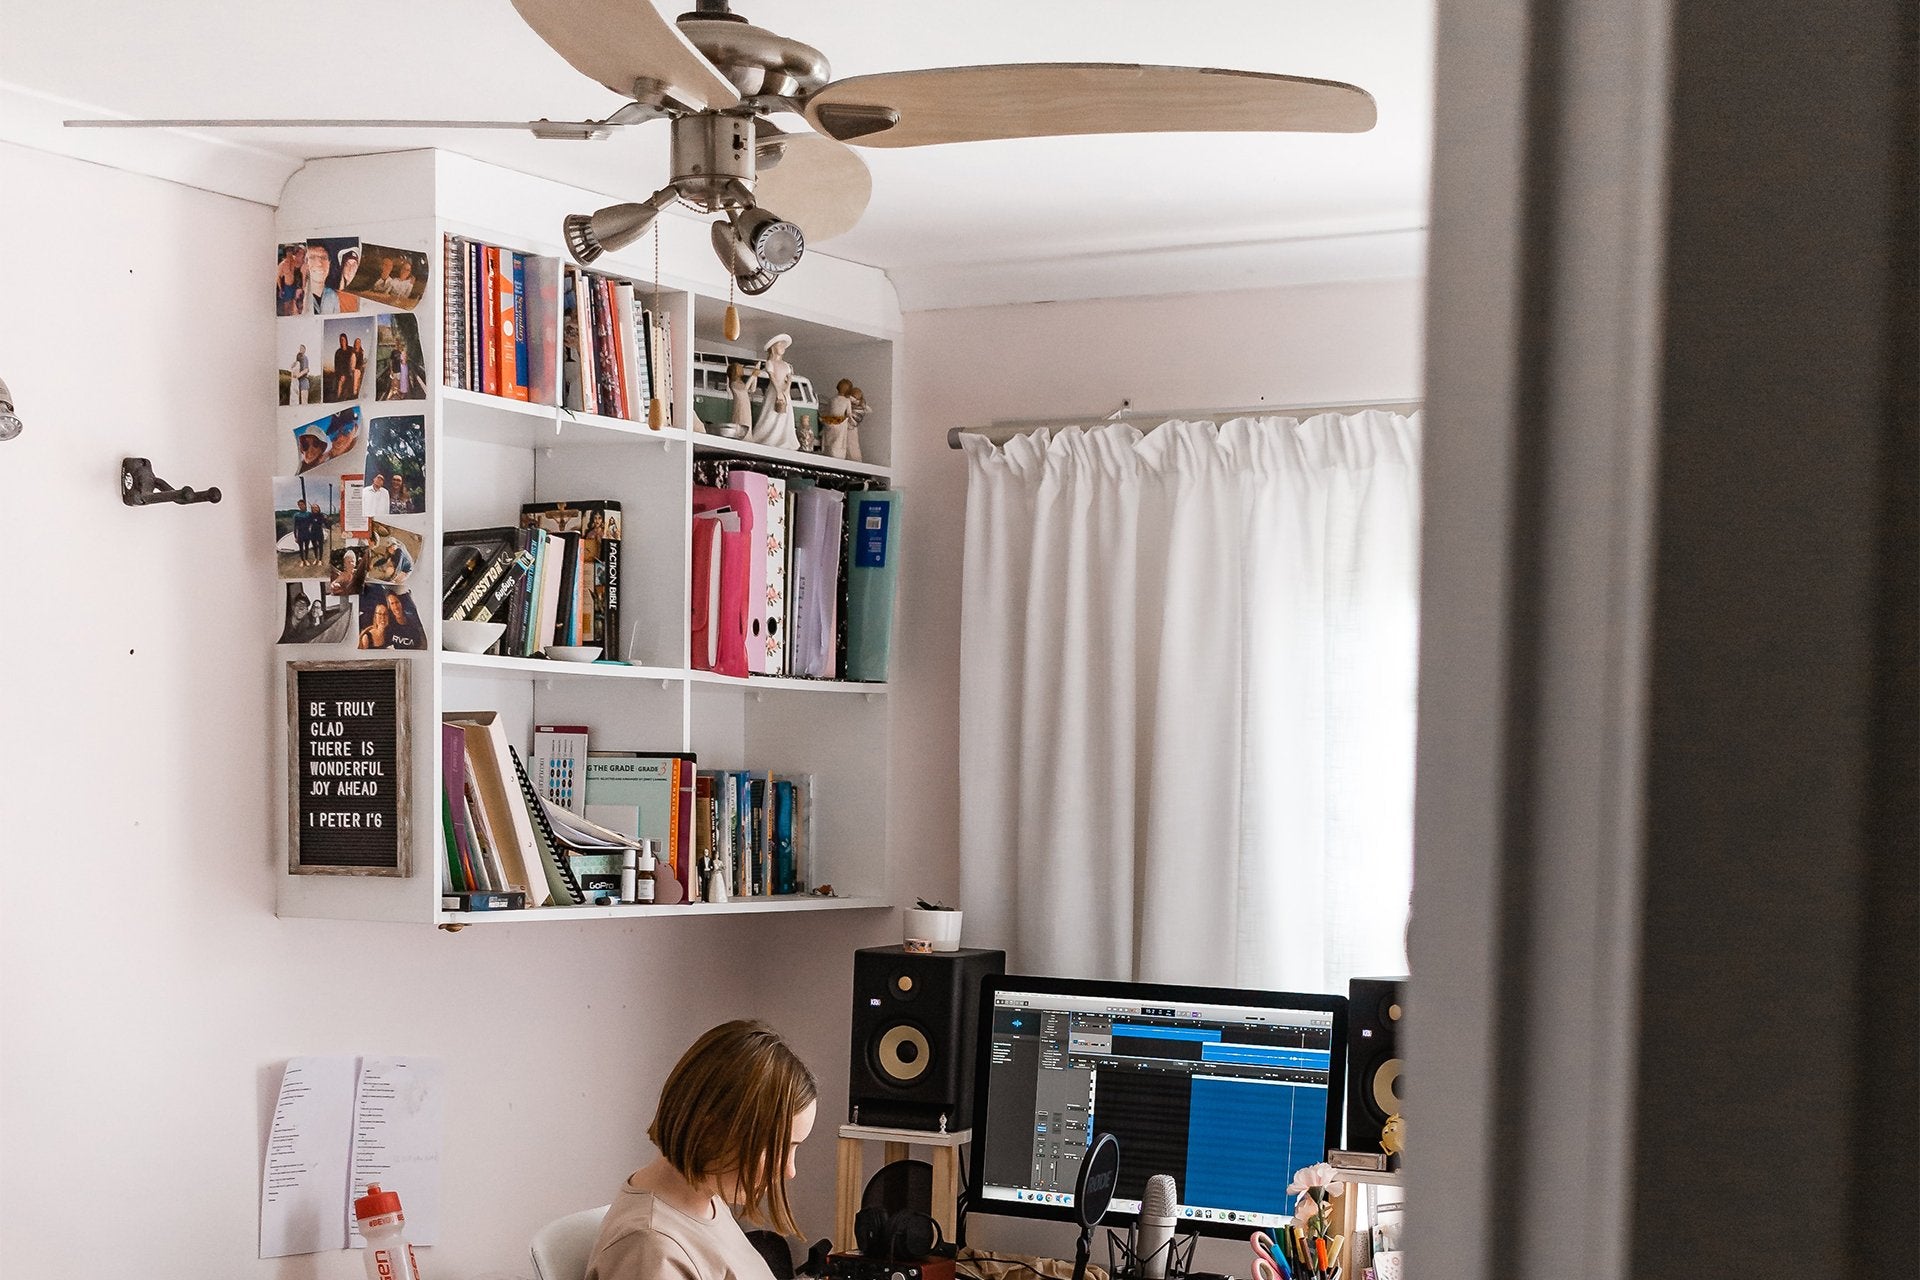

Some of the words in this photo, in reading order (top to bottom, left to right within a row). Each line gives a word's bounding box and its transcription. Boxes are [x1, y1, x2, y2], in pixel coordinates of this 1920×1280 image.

[609, 547, 618, 586] ACTION
[462, 568, 498, 612] CLASSICAL
[494, 576, 516, 601] Singing
[609, 587, 618, 610] BIBLE
[310, 702, 326, 717] BE
[336, 702, 375, 717] TRULY
[310, 722, 344, 737] GLAD
[310, 741, 351, 756] THERE
[361, 741, 374, 756] IS
[310, 762, 384, 776] WONDERFUL
[657, 762, 667, 776] 3
[310, 781, 330, 796] JOY
[337, 781, 378, 796] AHEAD
[319, 813, 361, 827] PETER
[589, 881, 615, 890] GoPro
